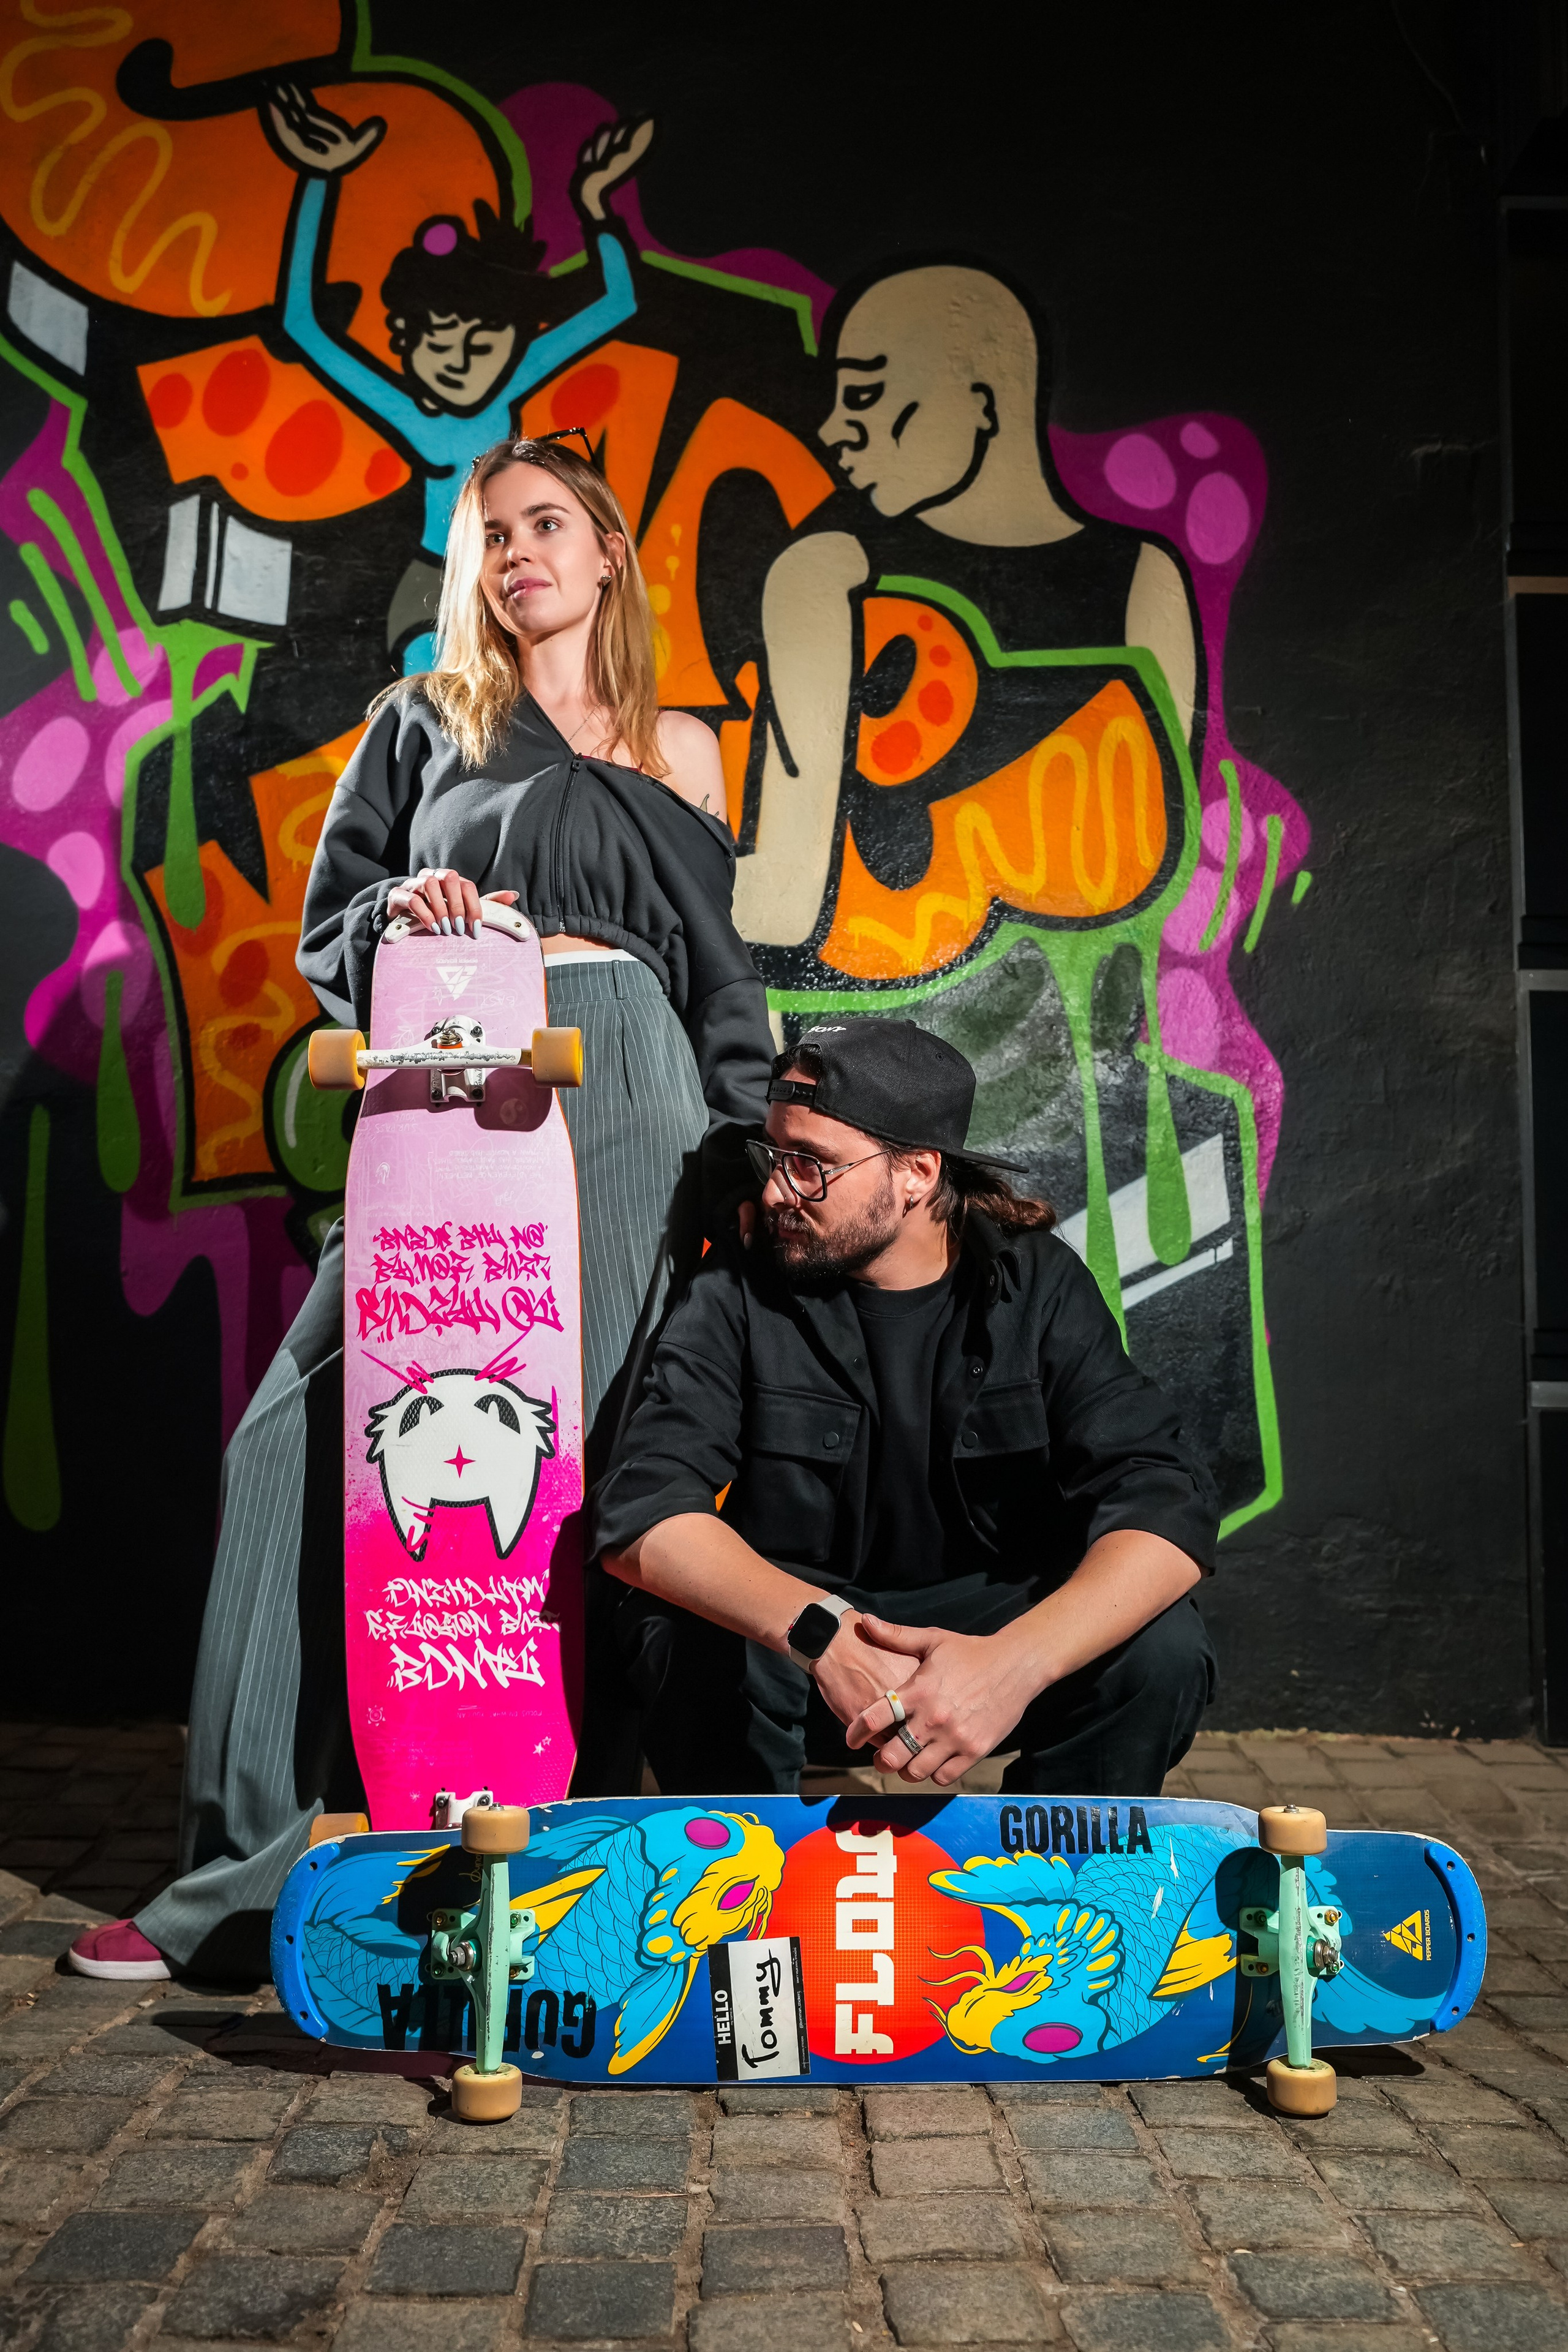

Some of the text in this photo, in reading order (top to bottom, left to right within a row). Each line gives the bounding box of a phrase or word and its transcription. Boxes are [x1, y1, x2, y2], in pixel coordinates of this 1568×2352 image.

[1000, 1804, 1153, 1854] GORILLA
[835, 1830, 897, 2054] FLOW
[714, 1989, 731, 2045] HELLO
[741, 1948, 781, 2069] Tommy
